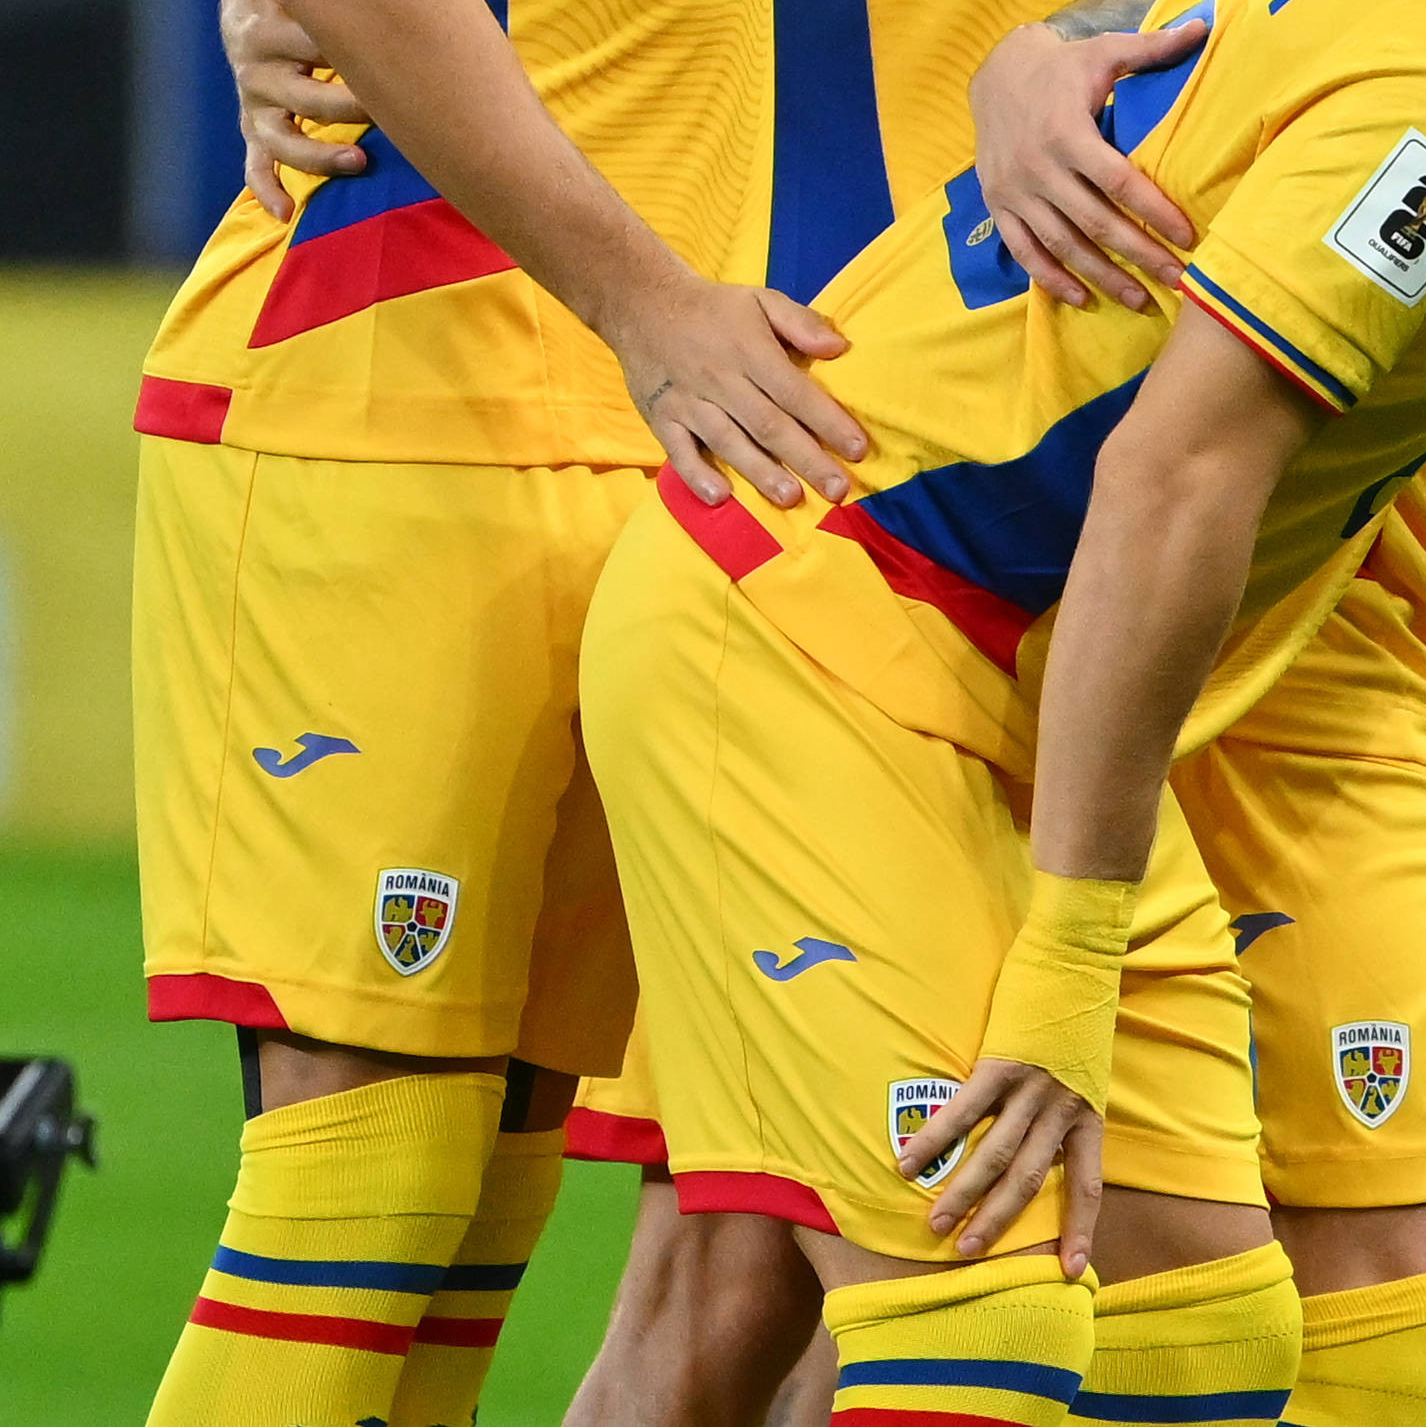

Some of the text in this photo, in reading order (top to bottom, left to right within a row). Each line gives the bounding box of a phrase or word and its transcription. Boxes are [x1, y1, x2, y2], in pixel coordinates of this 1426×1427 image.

[1389, 231, 1414, 253] FIFA
[384, 872, 450, 898] ROMÂNIA
[1338, 1022, 1402, 1047] ROMÂNIA
